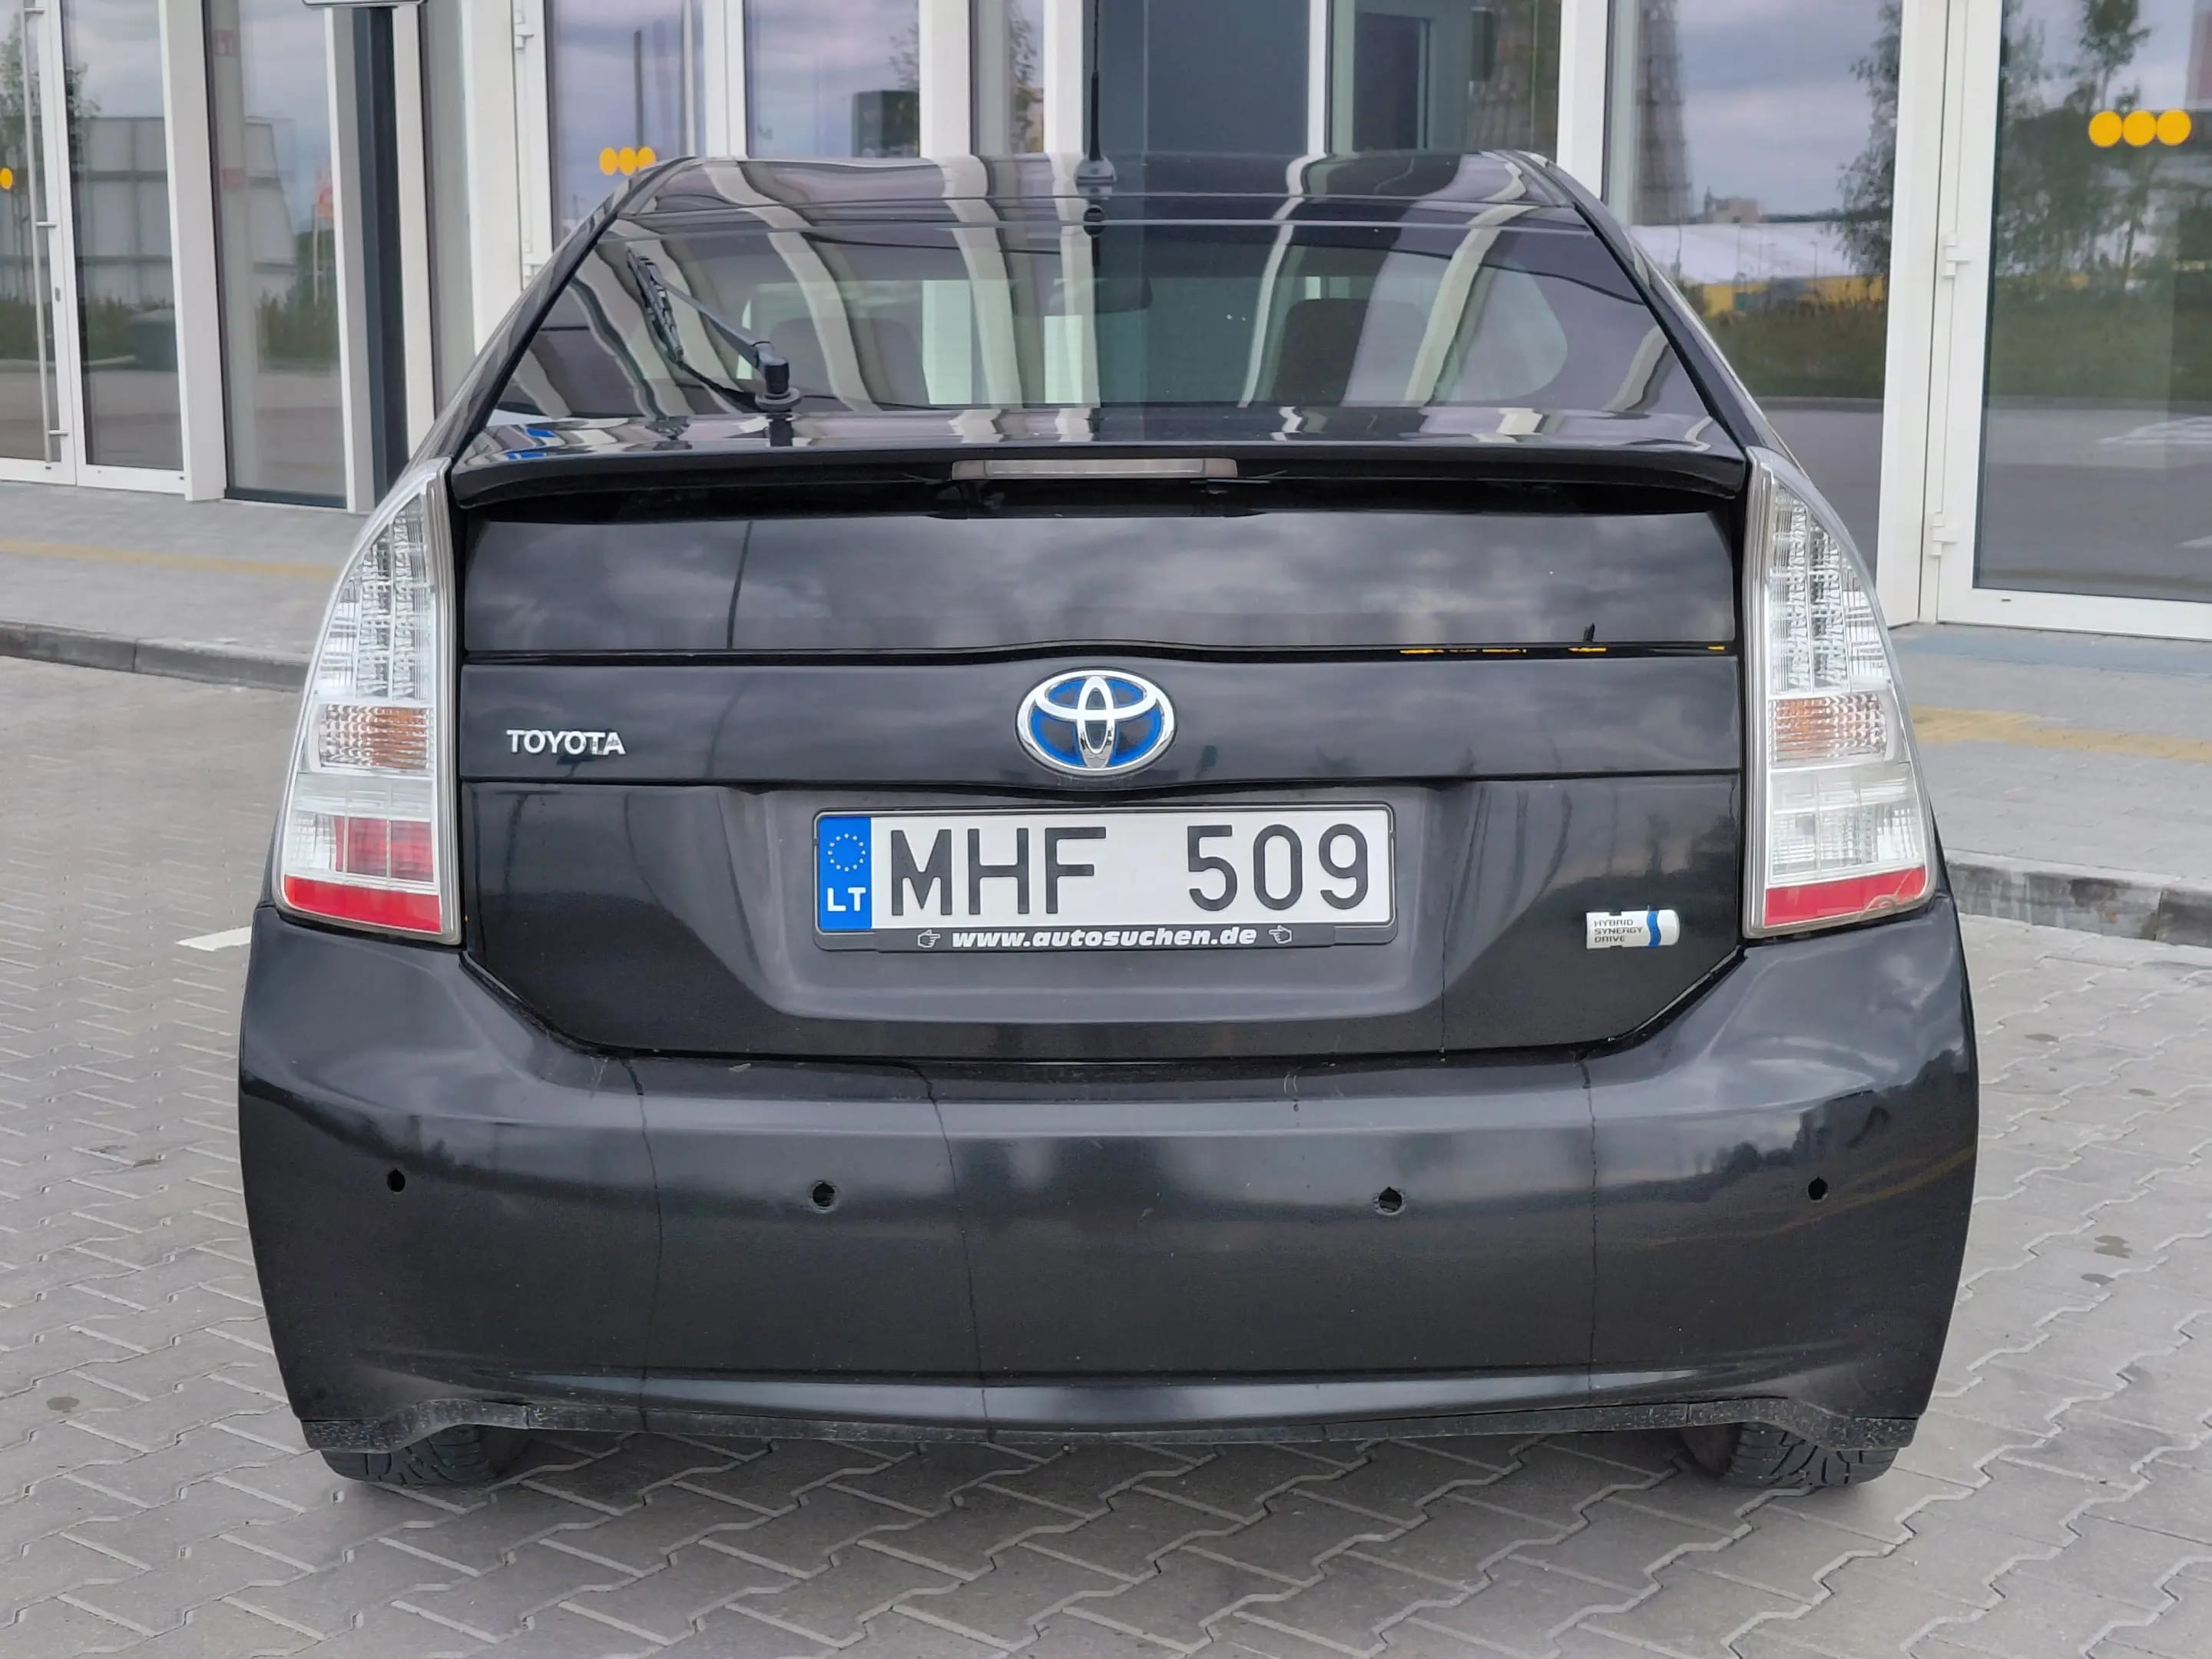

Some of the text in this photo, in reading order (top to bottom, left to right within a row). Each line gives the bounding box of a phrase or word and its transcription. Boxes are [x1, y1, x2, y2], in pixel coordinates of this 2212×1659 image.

[506, 729, 626, 755] TOYOTA
[890, 823, 1368, 916] MHF 509
[827, 887, 866, 912] LT
[952, 927, 1257, 948] www.autosuchen.de
